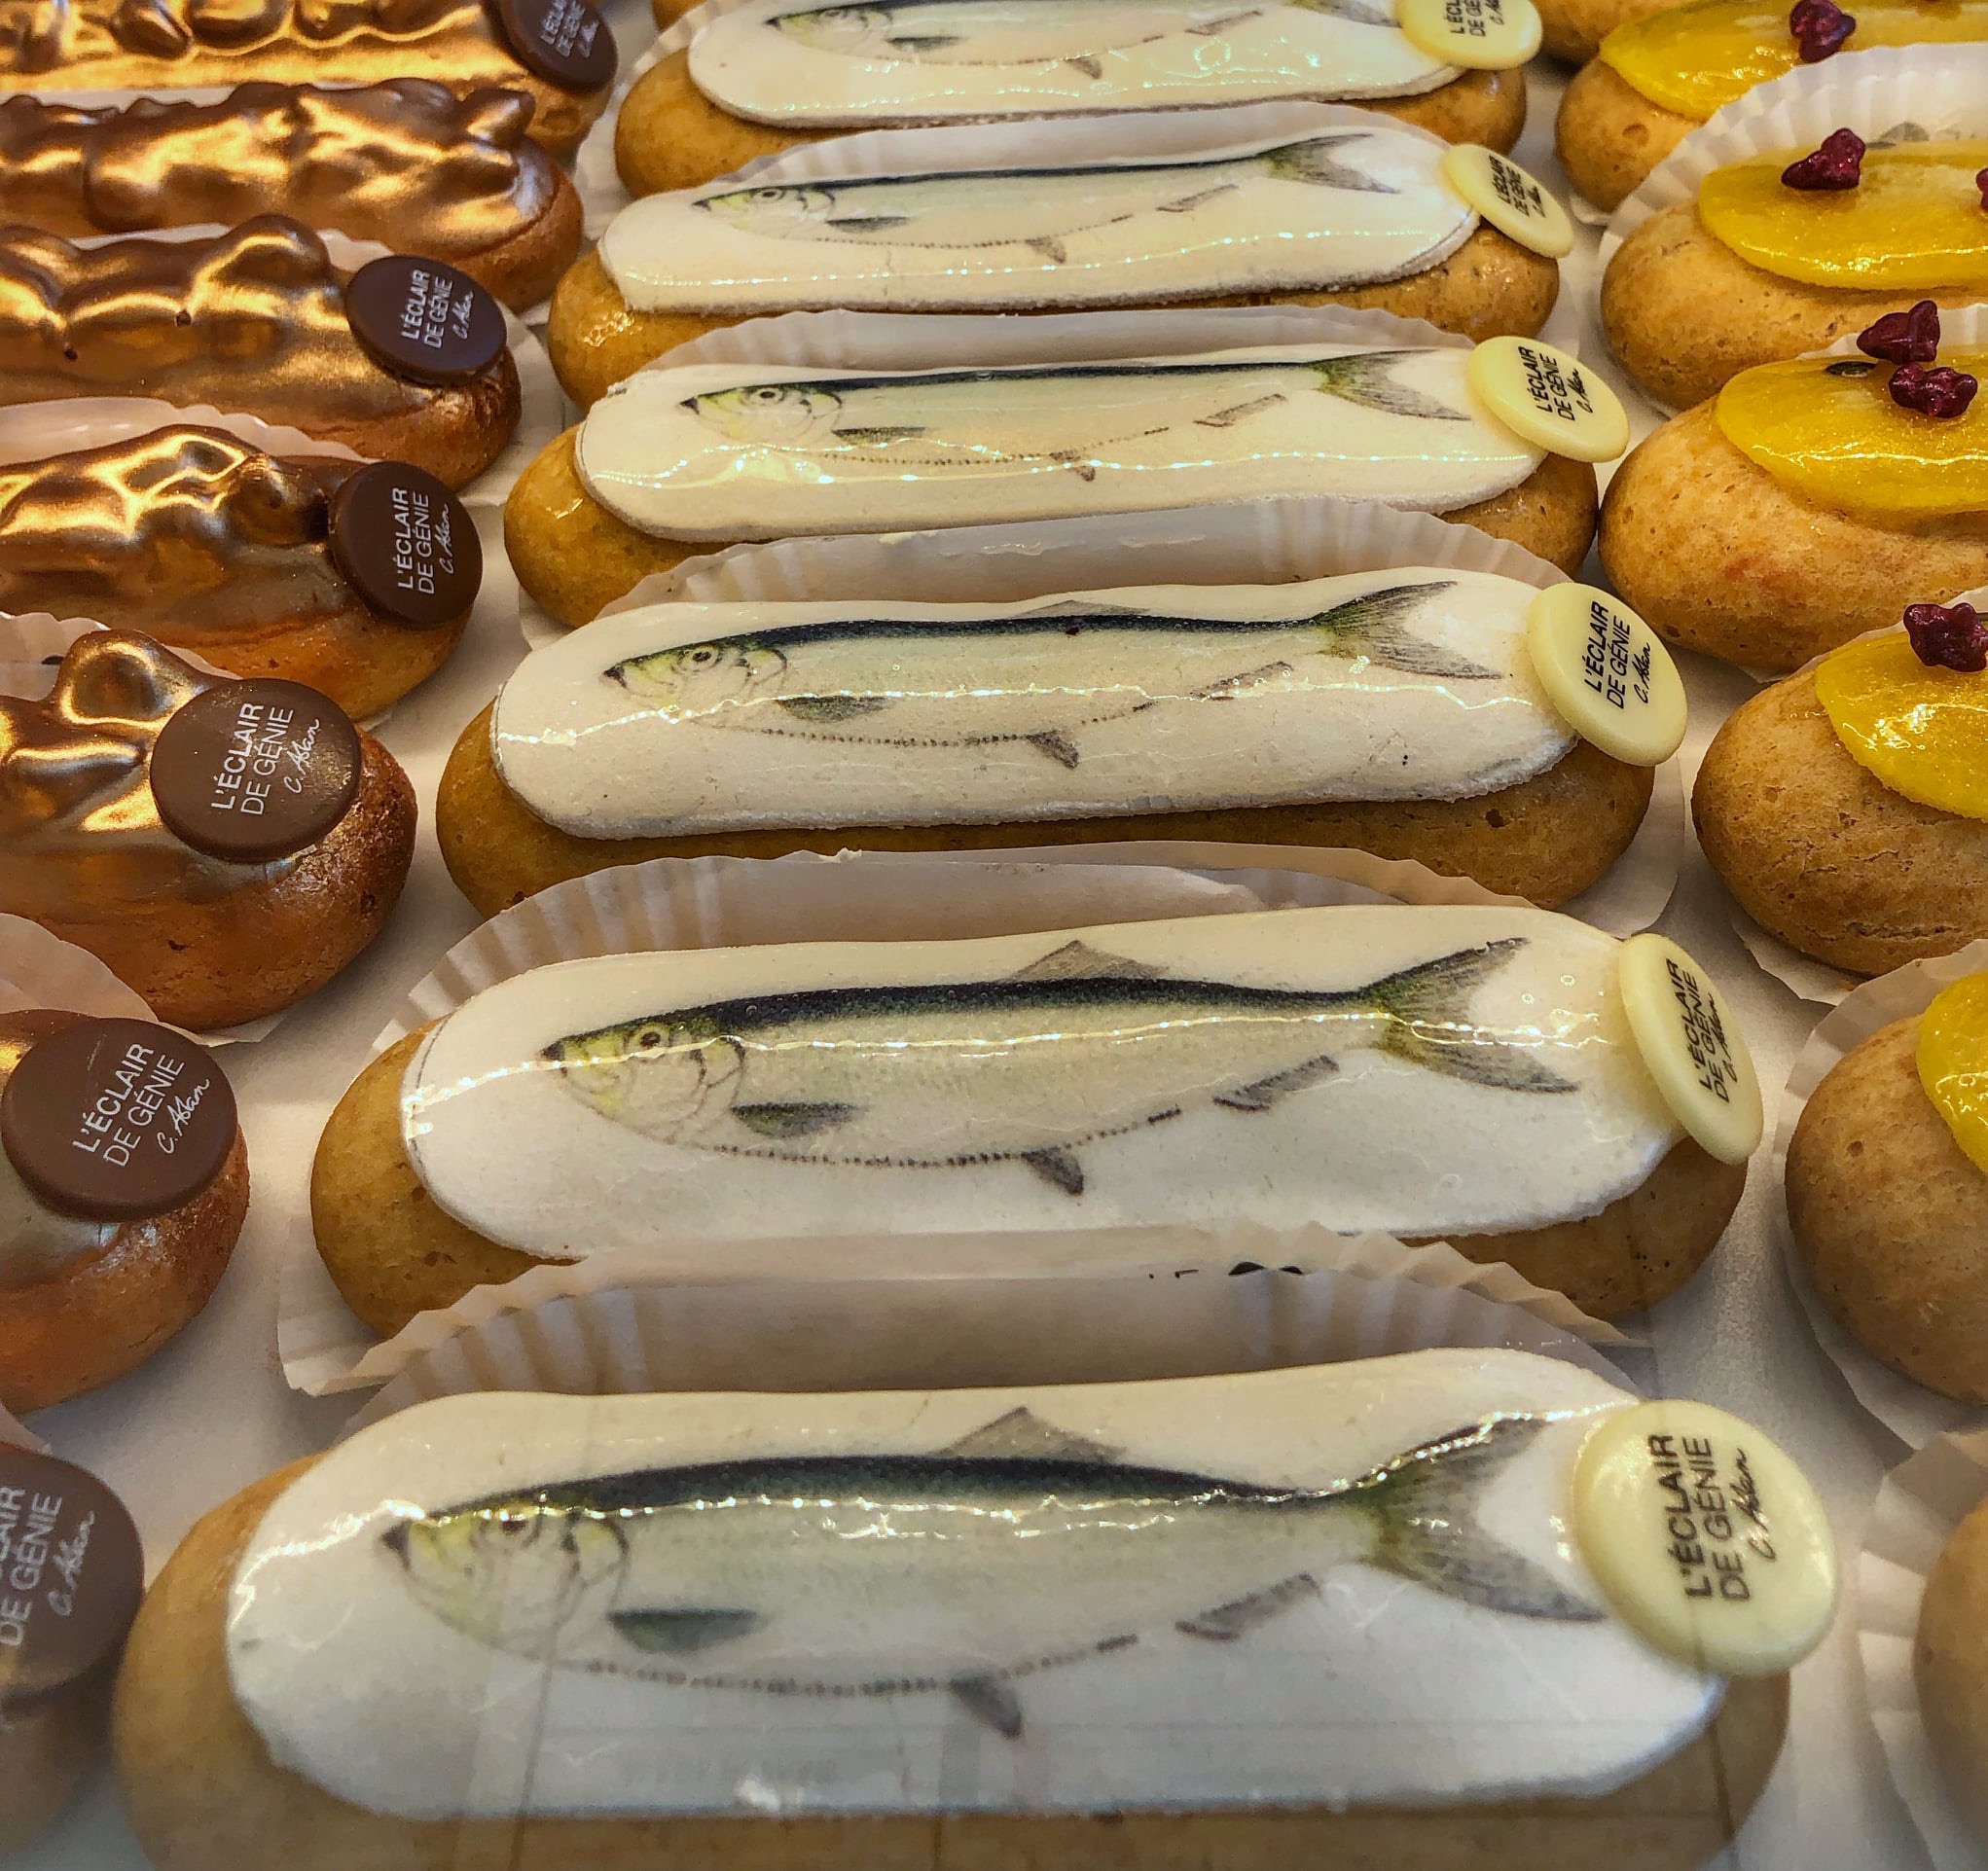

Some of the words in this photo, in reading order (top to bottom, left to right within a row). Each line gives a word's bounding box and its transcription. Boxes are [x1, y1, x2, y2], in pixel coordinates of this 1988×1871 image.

[1444, 0, 1465, 34] L'ÉCL
[1466, 18, 1486, 37] DE
[400, 270, 431, 341] L'ÉCLAIR
[428, 276, 453, 323] GÉNIE
[423, 323, 445, 348] DE
[1518, 345, 1553, 413] L'ÉCLAIR
[1539, 353, 1568, 397] GÉNIE
[1554, 397, 1575, 421] DE
[392, 487, 414, 590] L'ÉCLAIR
[413, 491, 432, 558] GÉNIE
[417, 561, 435, 594] DE
[1581, 600, 1608, 693] L'ÉCLAIR
[1608, 615, 1630, 676] GÉNIE
[1607, 674, 1626, 709] DE
[210, 702, 265, 810] L'ÉCLAIR
[253, 706, 294, 775] GÉNIE
[240, 780, 271, 815] DE
[1666, 958, 1713, 1091] L'ÉCLAIR
[1681, 969, 1716, 1055] GÉNIE
[72, 1043, 155, 1153] L'ÉCLAIR
[102, 1127, 141, 1167] DE
[127, 1054, 185, 1126] GÉNIE
[1708, 1060, 1730, 1103] DE
[1647, 1434, 1713, 1597] L'ÉCLAIR
[1681, 1436, 1732, 1540] GÉNIE
[10, 1493, 63, 1591] GÉNIE
[1713, 1551, 1750, 1599] DE
[0, 1597, 32, 1646] DE
